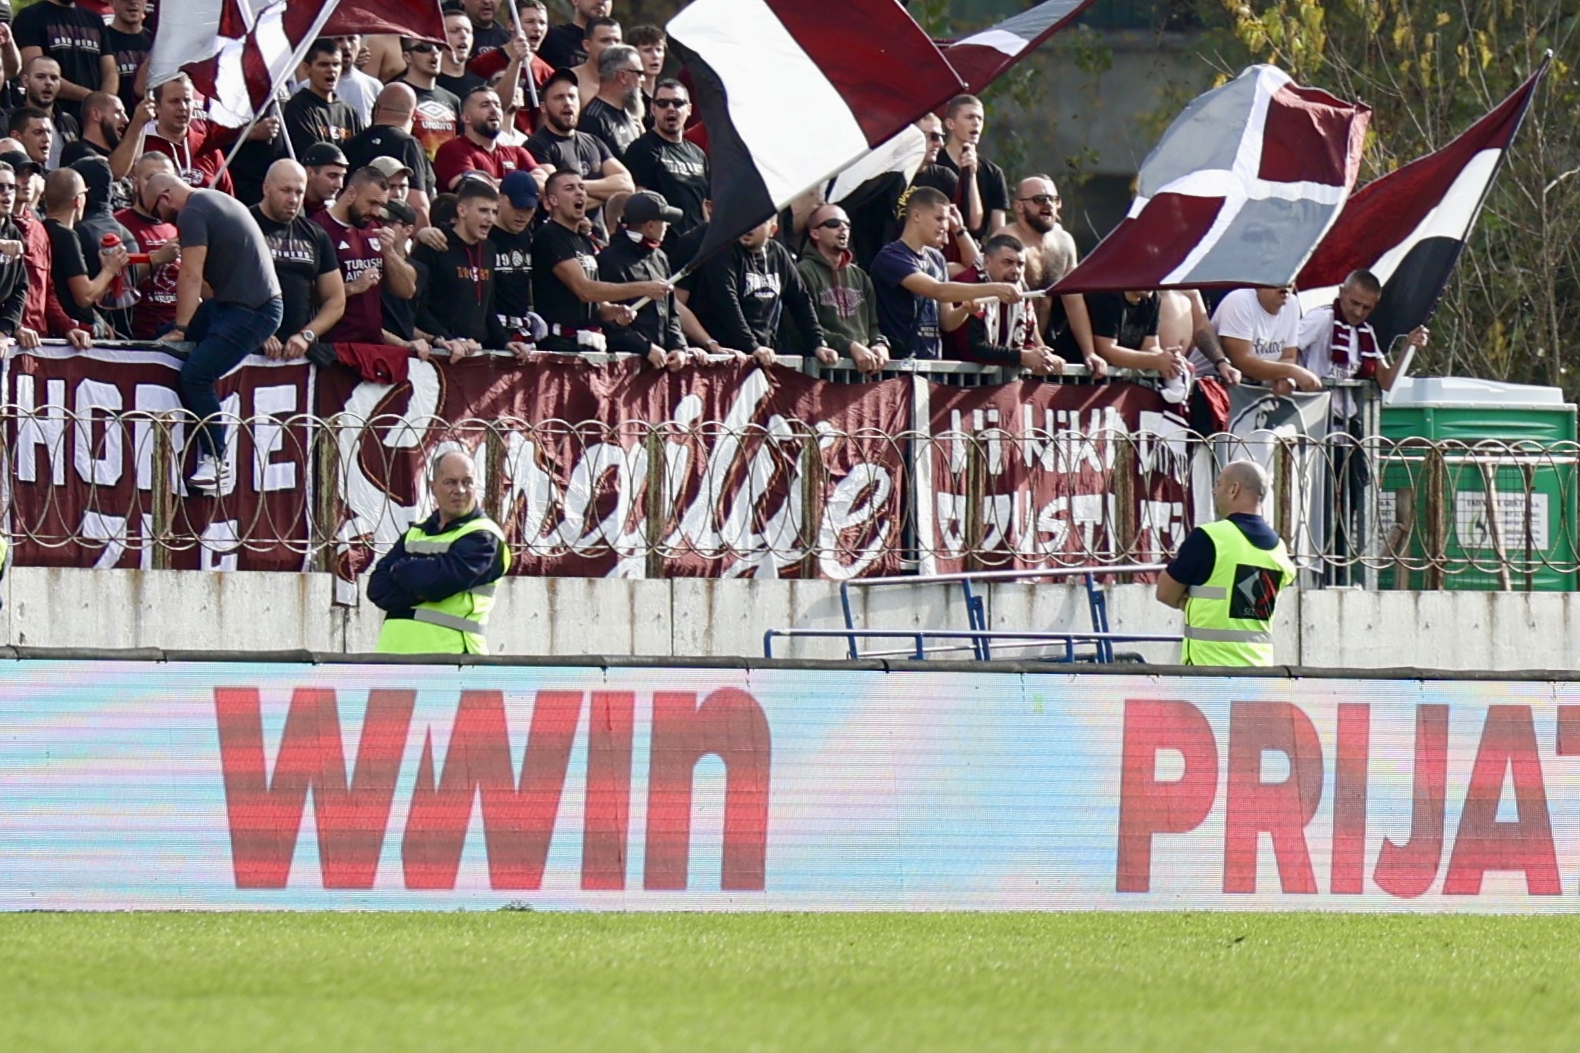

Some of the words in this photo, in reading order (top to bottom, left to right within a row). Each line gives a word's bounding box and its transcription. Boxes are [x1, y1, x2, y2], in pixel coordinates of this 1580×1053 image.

[422, 121, 453, 131] umbro
[344, 258, 383, 271] TURKISH
[1116, 699, 1580, 898] PRIJA
